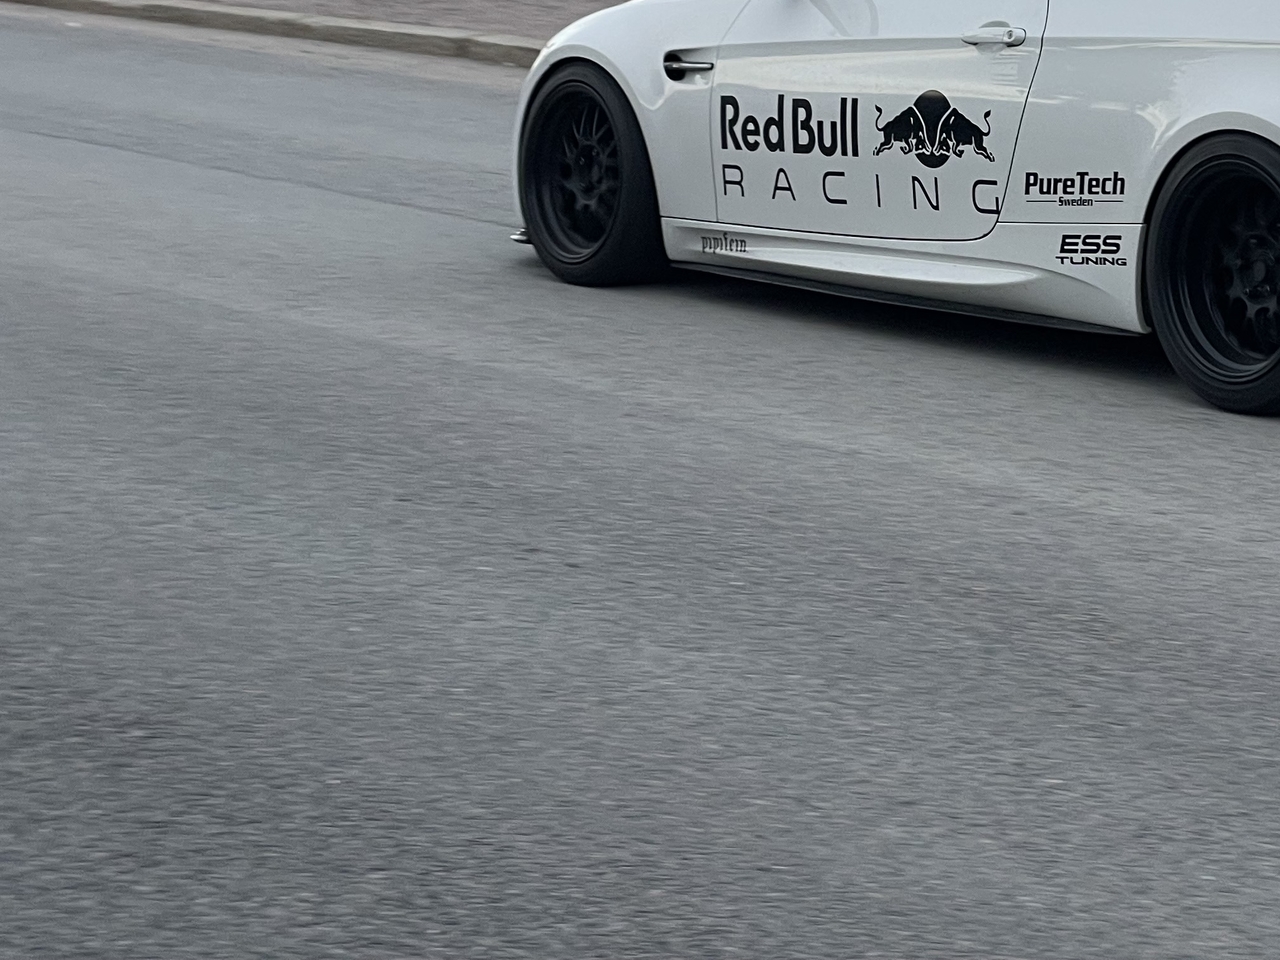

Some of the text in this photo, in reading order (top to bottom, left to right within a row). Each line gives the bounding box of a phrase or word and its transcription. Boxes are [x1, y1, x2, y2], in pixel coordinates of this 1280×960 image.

[719, 94, 859, 157] Red Bull
[722, 164, 1000, 215] RACING
[1024, 170, 1126, 196] PureTech
[1058, 196, 1094, 207] Sweden
[1060, 234, 1122, 255] ESS
[1055, 255, 1128, 267] TUNING
